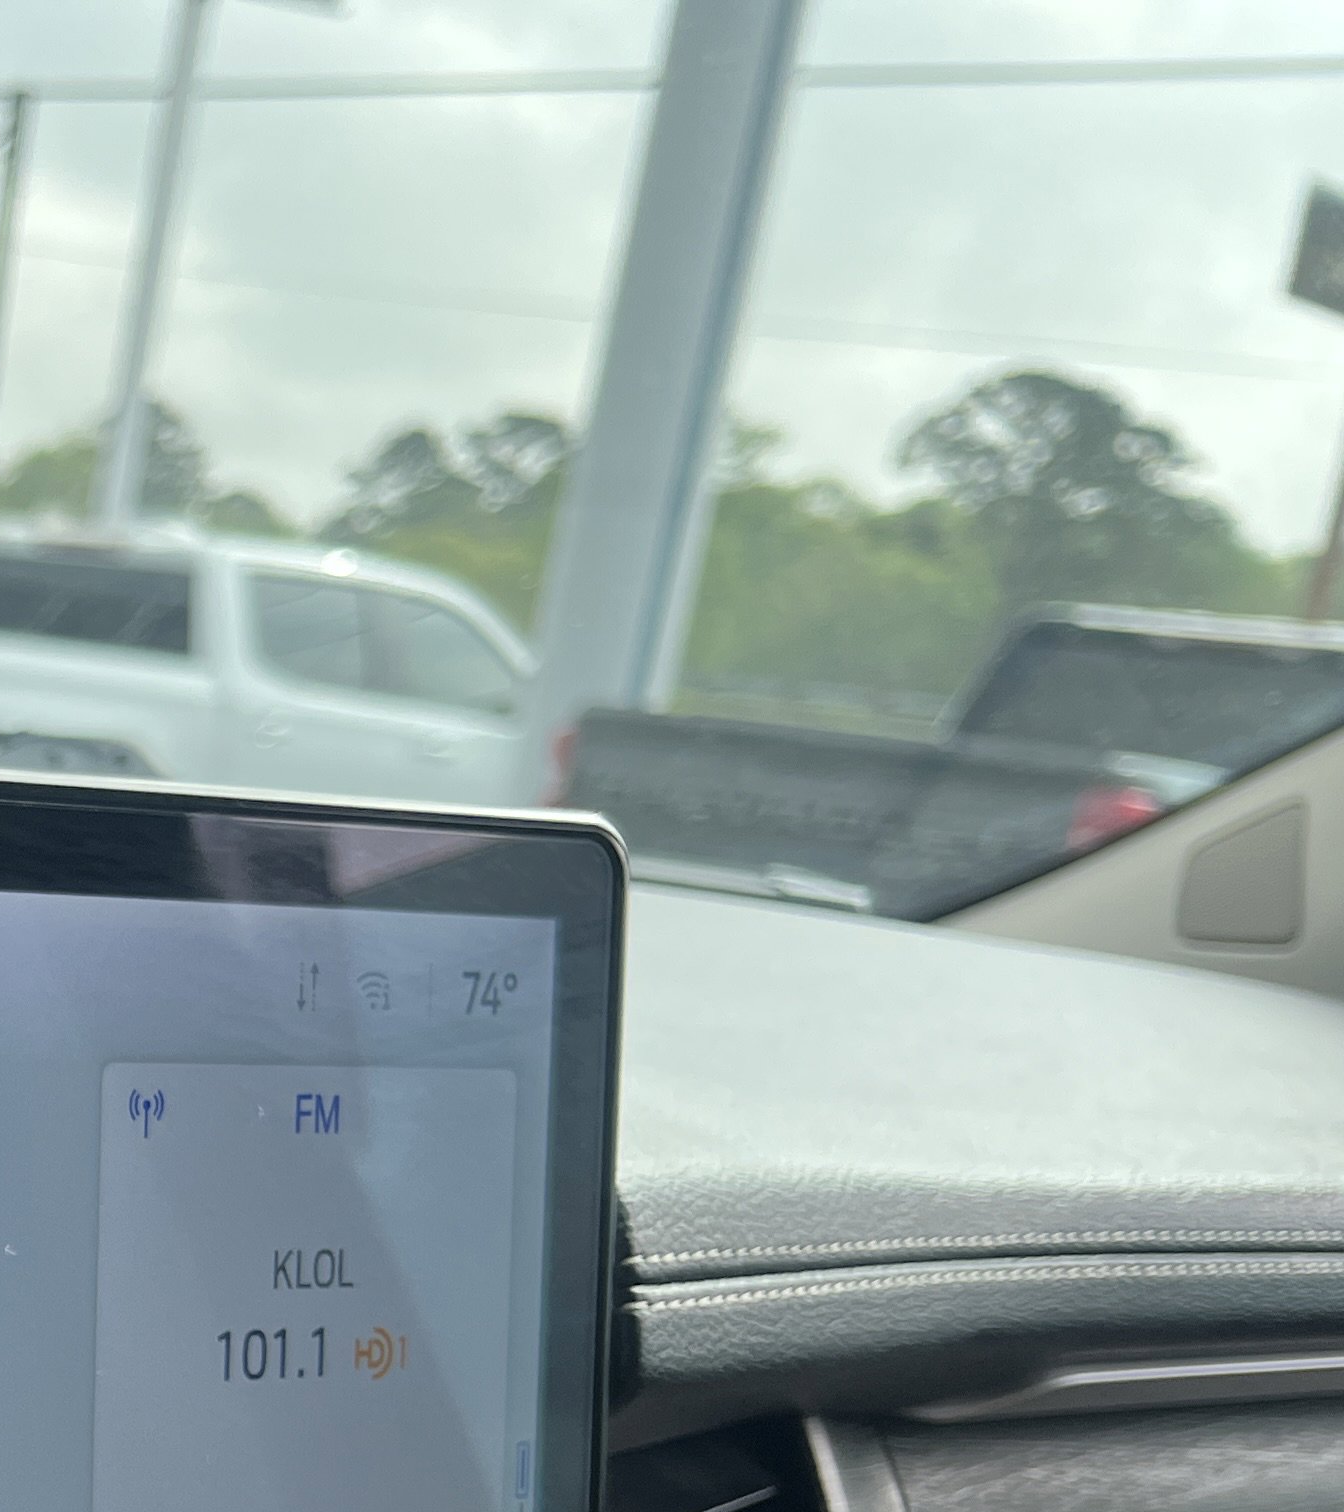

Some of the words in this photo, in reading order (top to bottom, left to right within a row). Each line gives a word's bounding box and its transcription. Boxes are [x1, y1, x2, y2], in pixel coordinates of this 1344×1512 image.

[462, 970, 518, 1016] 74°
[294, 1093, 341, 1135] FM
[272, 1248, 354, 1290] KLOL
[217, 1325, 325, 1382] 101.1
